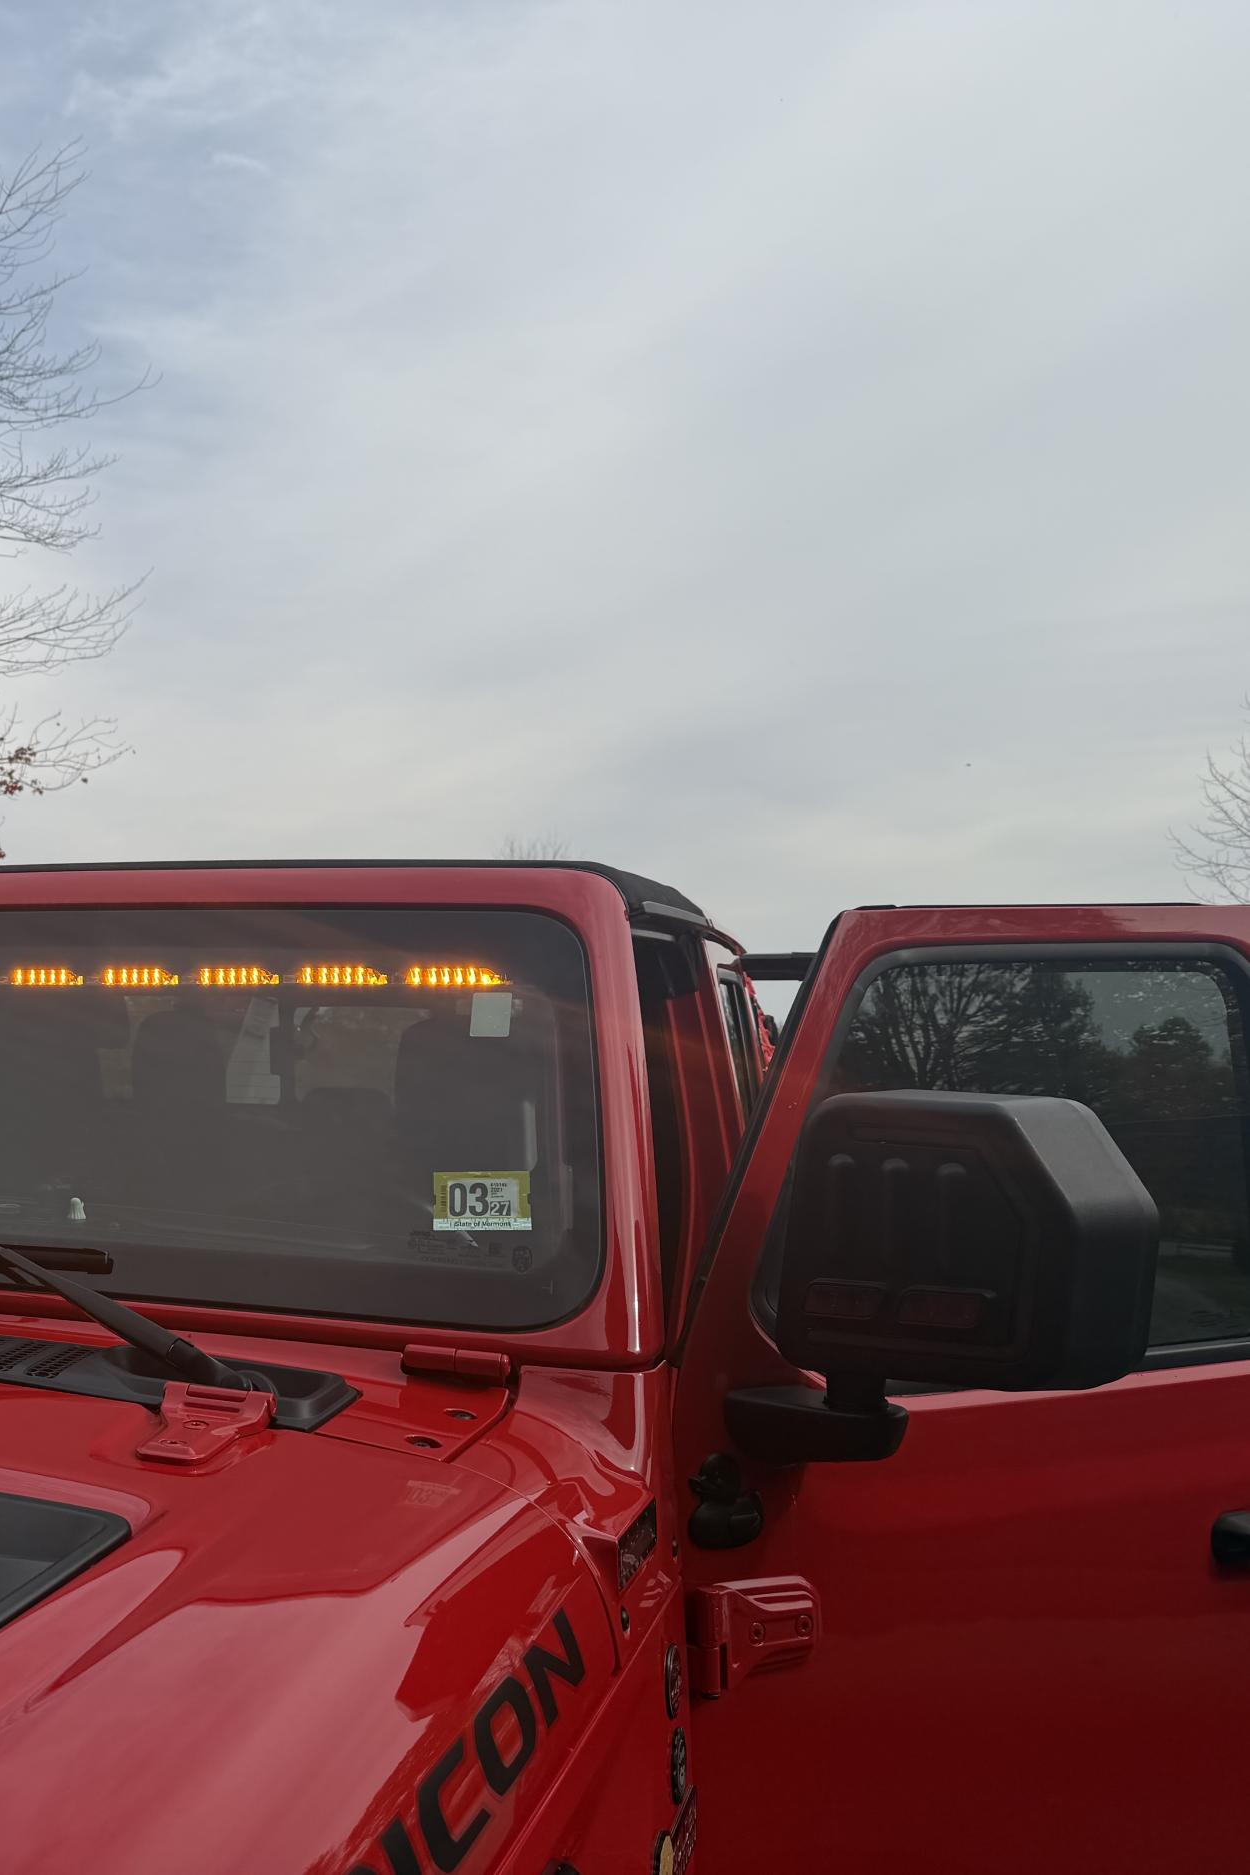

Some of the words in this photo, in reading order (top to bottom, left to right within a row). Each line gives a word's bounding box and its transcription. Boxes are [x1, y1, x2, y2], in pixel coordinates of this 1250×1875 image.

[449, 1182, 490, 1217] 03
[490, 1201, 511, 1216] 27
[348, 1608, 586, 1875] ICON
